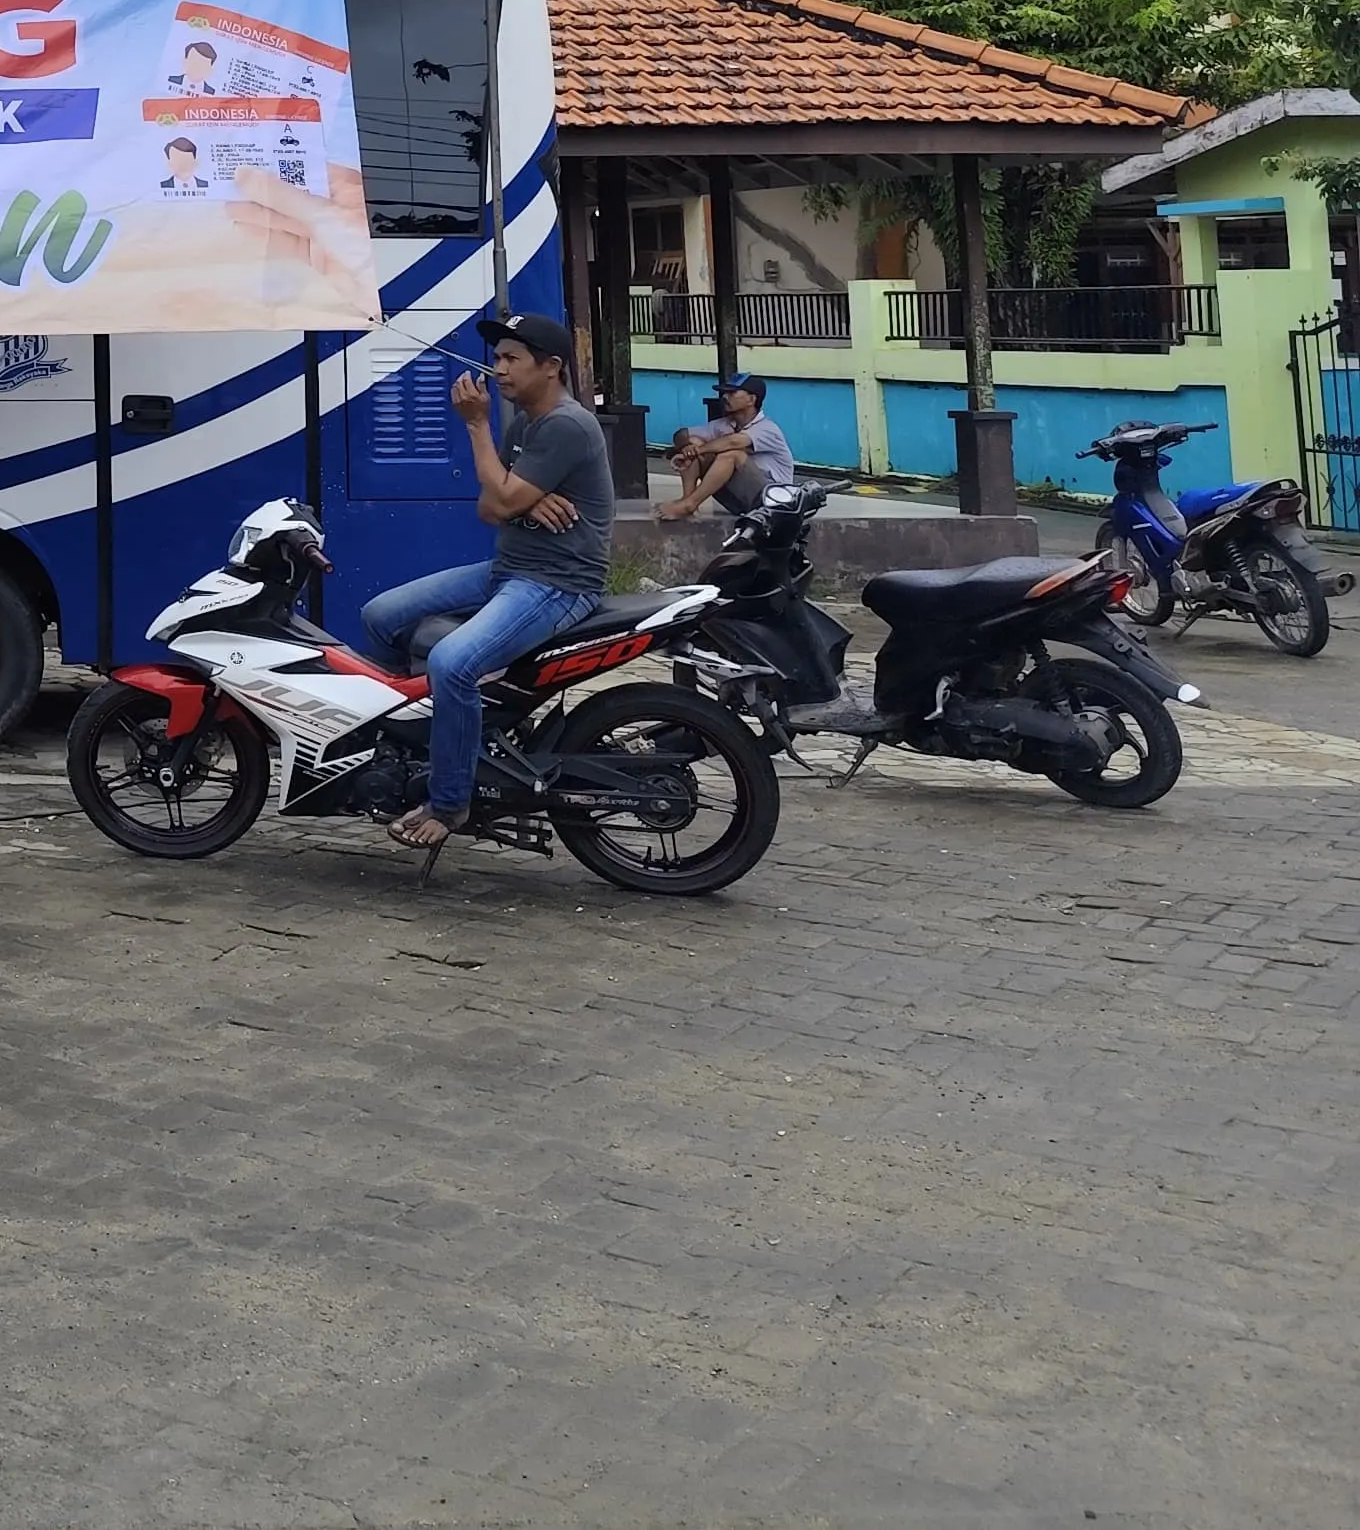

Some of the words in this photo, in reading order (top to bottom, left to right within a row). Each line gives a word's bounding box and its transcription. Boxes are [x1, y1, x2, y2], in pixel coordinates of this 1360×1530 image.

[217, 18, 289, 51] INDONESIA
[184, 109, 259, 120] INDONESIA
[533, 633, 654, 687] 150
